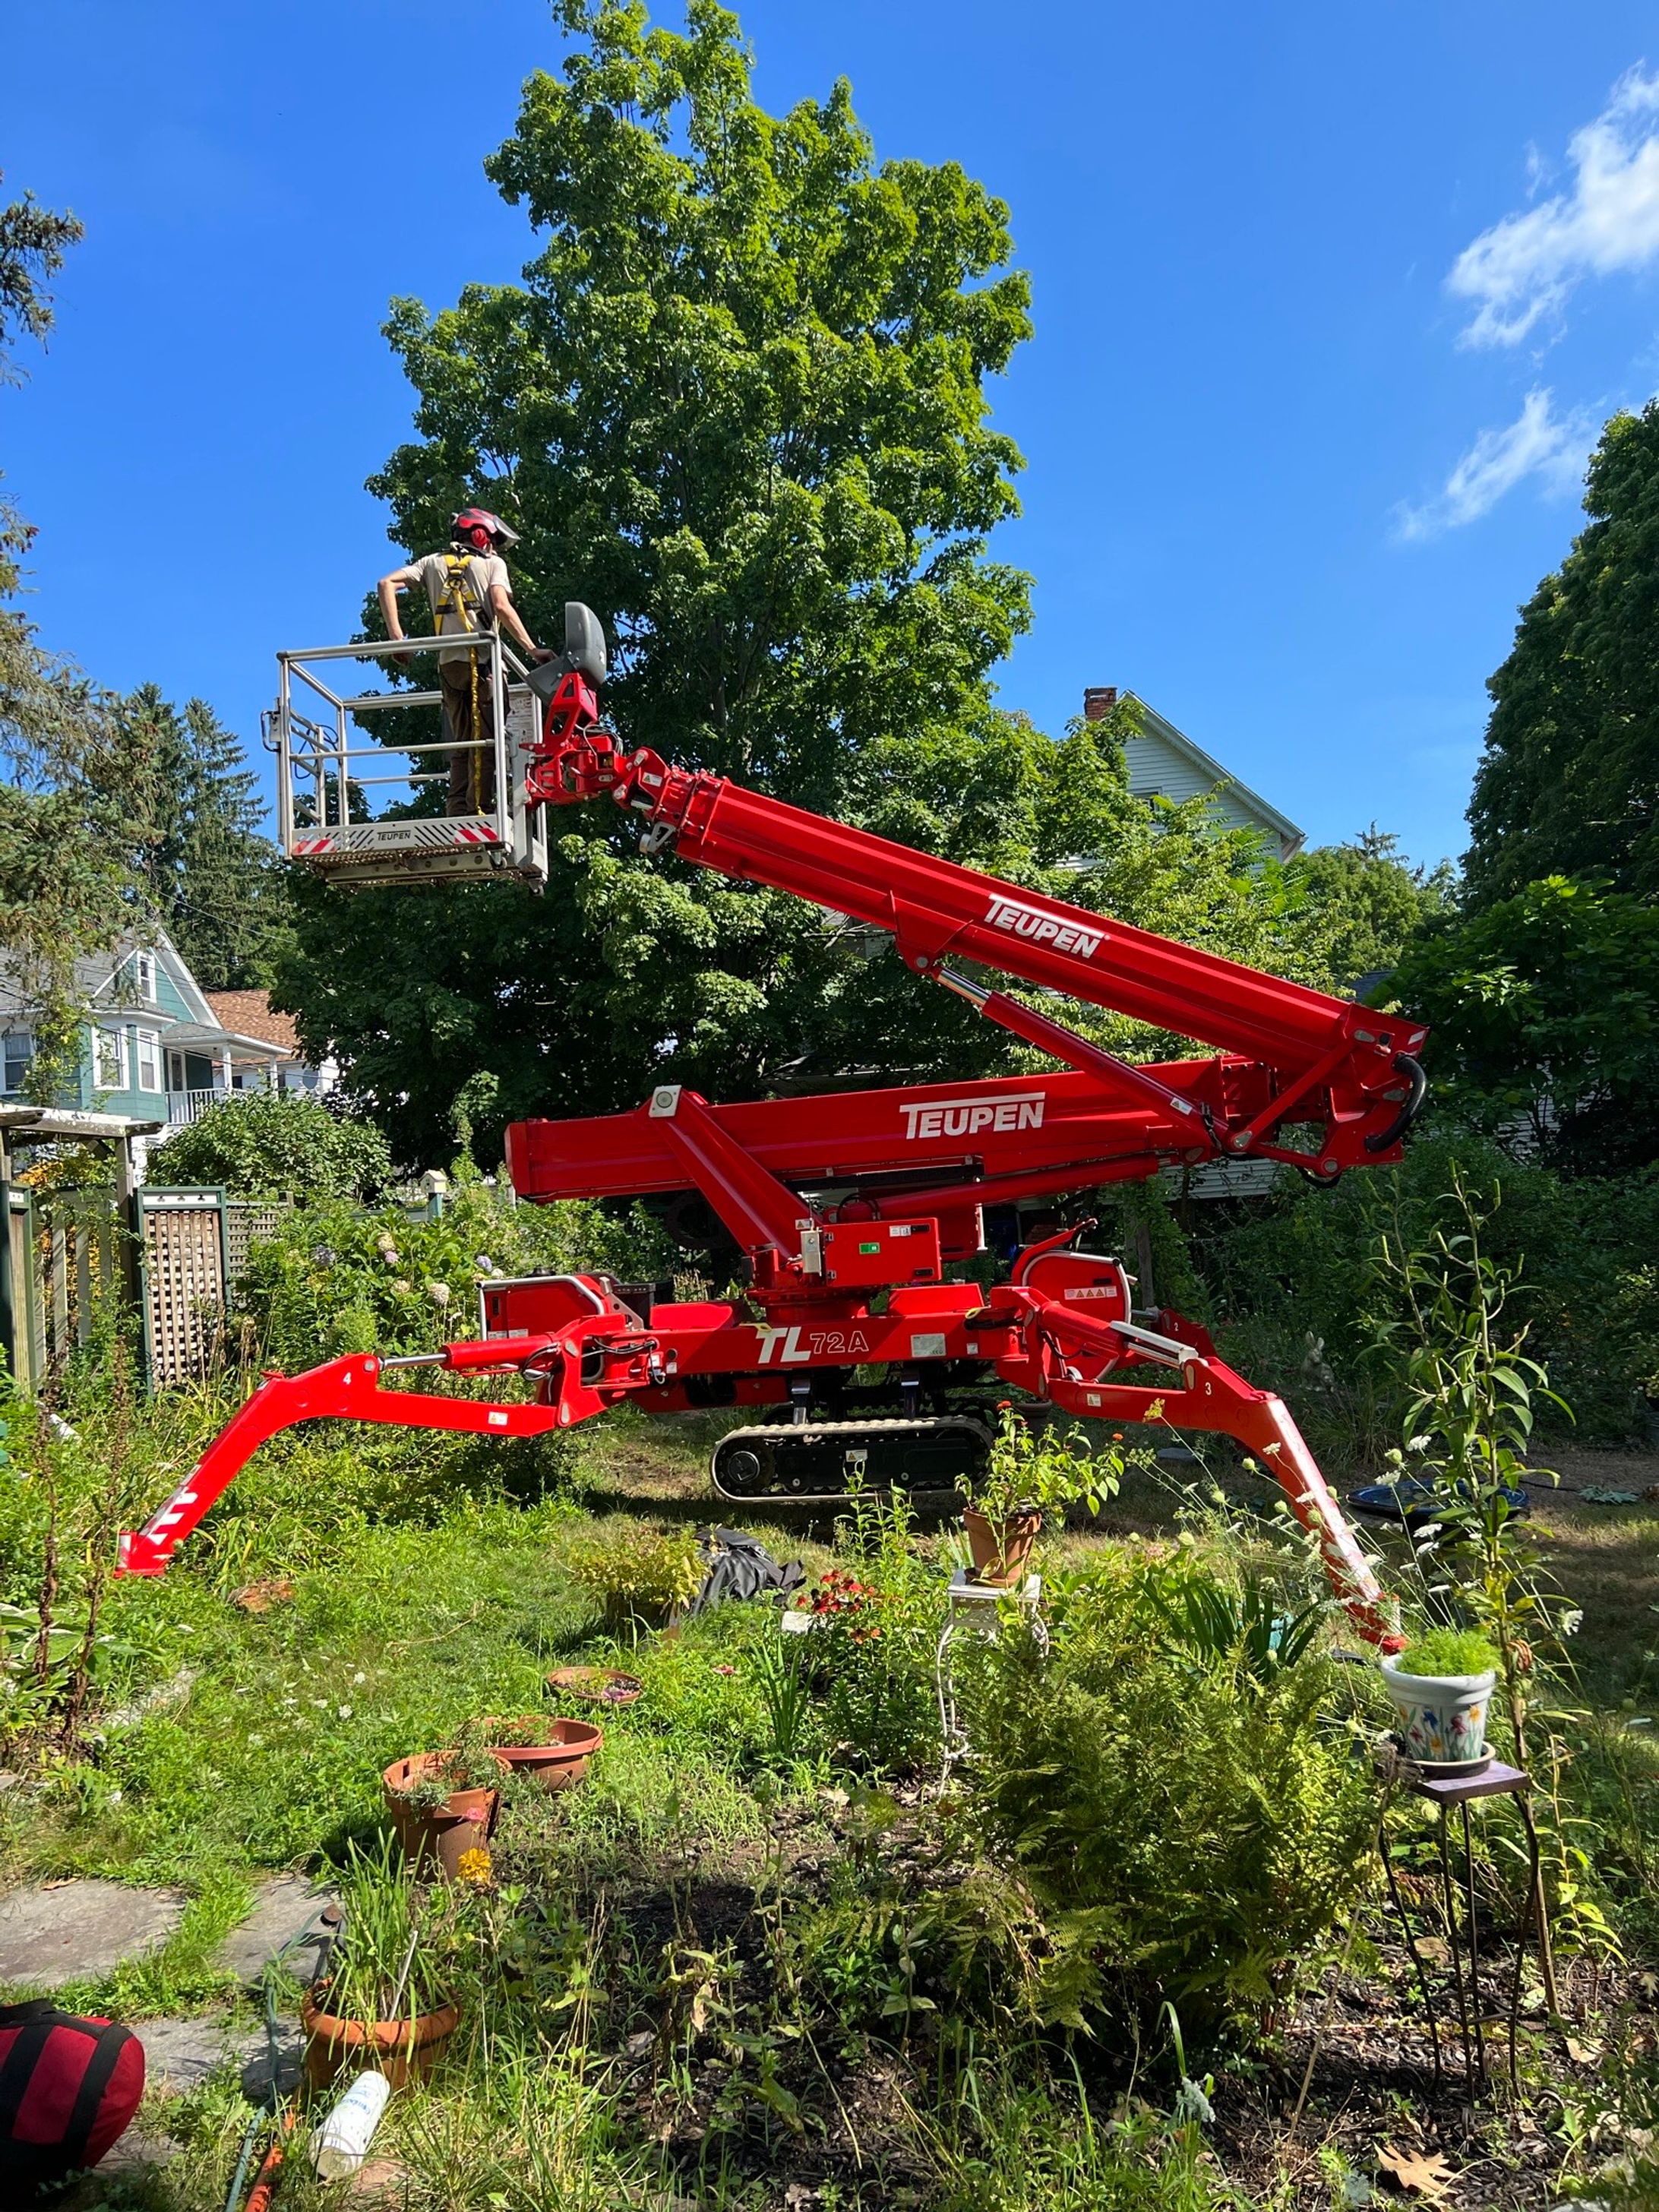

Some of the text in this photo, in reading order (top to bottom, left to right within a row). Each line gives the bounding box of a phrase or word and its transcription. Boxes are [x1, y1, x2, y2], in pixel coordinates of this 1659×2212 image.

[377, 830, 411, 841] TEUPEN
[984, 893, 1105, 959] TEUPEN
[899, 1092, 1046, 1139] TEUPEN
[1174, 1322, 1179, 1332] 2
[756, 1326, 811, 1364] TL
[343, 1371, 352, 1385] 4
[1205, 1382, 1212, 1395] 3
